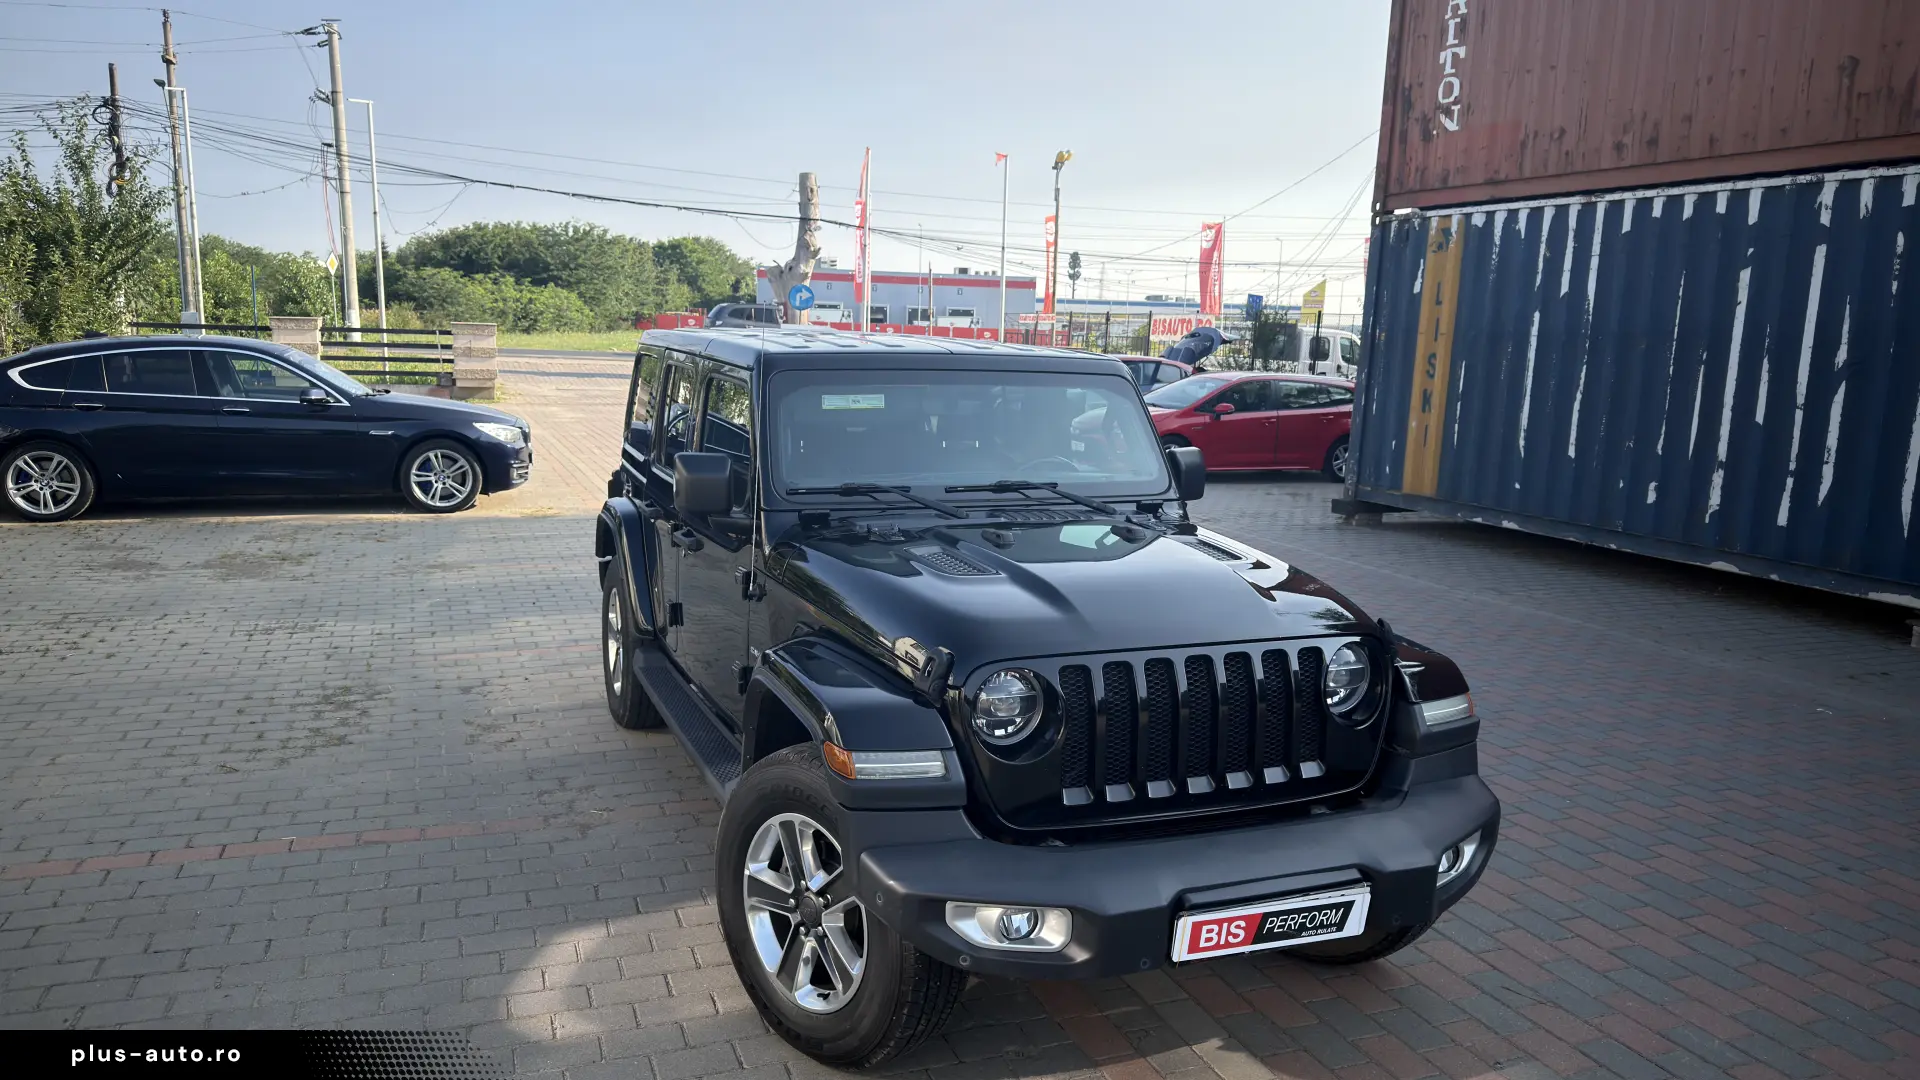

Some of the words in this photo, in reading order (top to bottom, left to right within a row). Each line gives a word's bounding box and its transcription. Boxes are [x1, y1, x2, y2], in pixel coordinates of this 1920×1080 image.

[1421, 281, 1444, 448] LISKI
[1199, 920, 1247, 948] BIS
[1262, 907, 1345, 935] PERFORM
[1300, 929, 1317, 937] AUTO
[1317, 926, 1338, 935] RULATE
